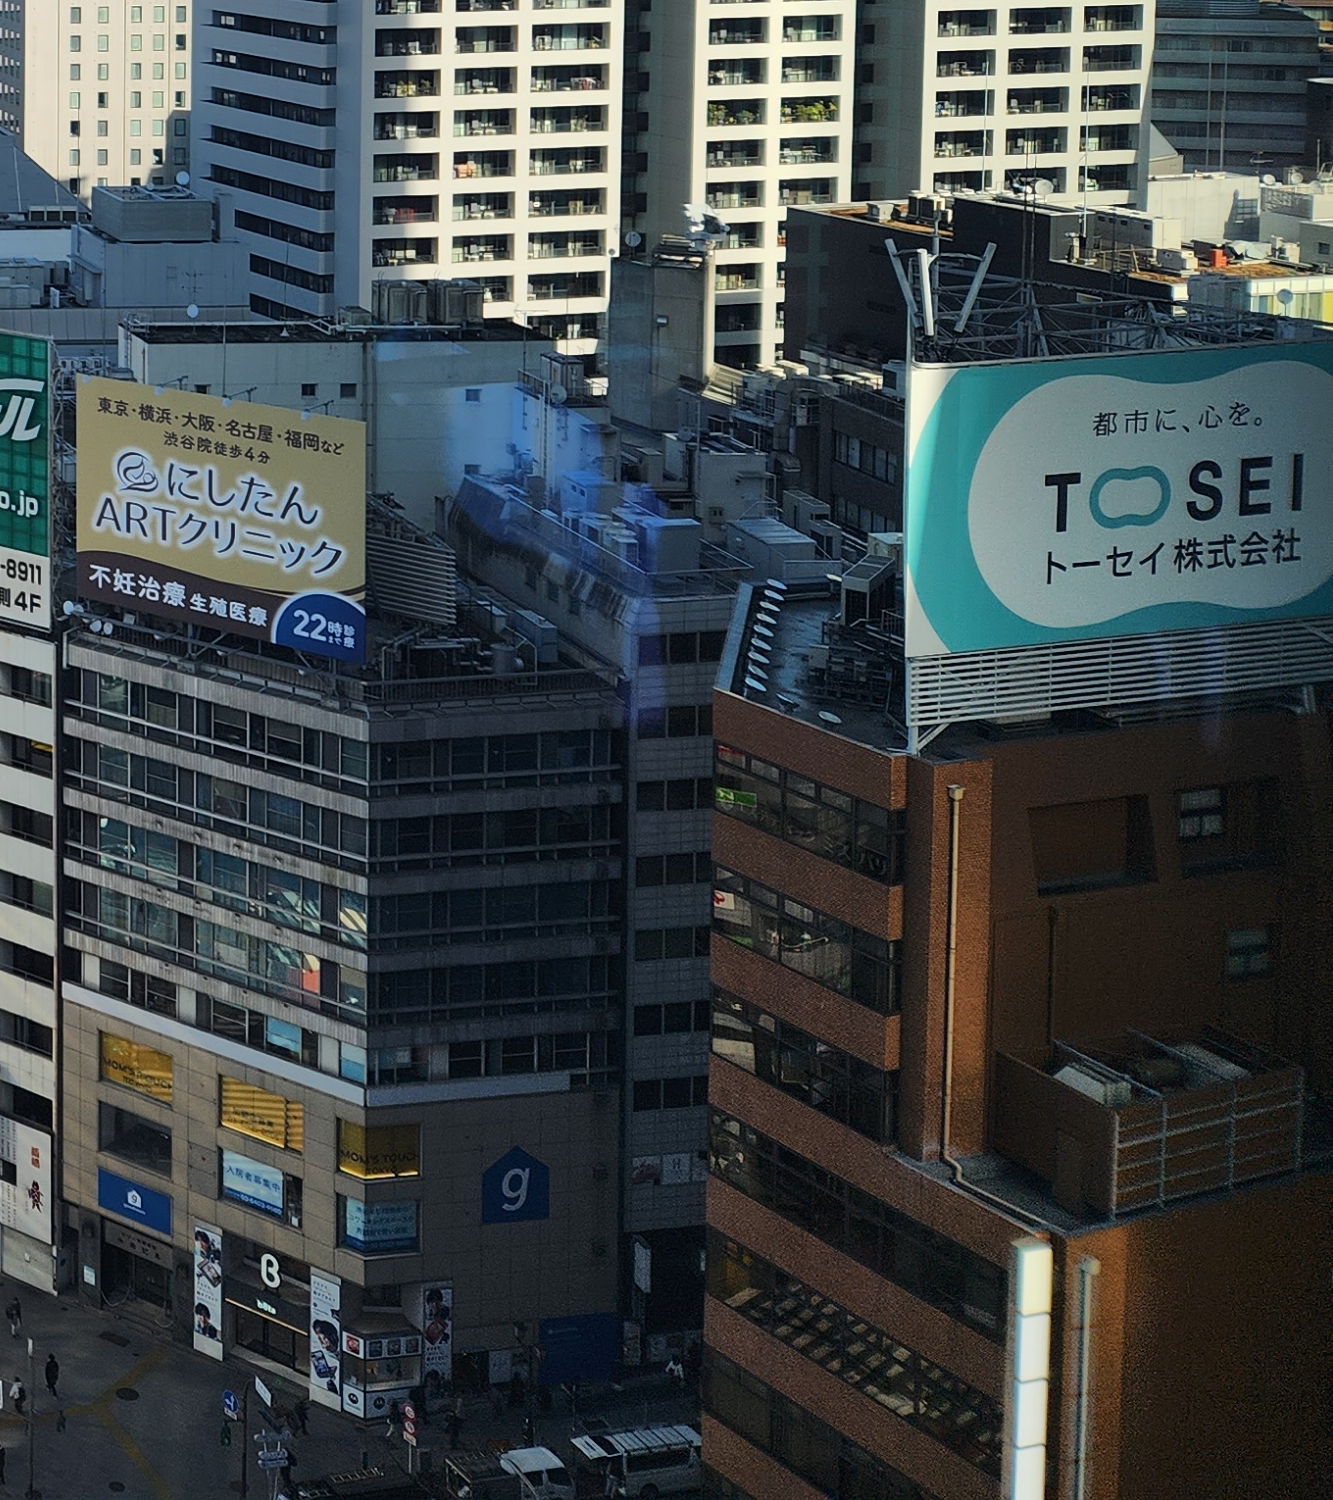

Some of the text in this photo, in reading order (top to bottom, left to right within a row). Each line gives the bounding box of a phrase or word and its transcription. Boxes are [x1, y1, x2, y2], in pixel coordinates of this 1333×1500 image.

[97, 397, 344, 456] 東京・横浜・大阪・名古屋・福岡など
[164, 431, 270, 464] 渋谷院徒歩4分
[1093, 402, 1263, 437] 都市に、心を。
[168, 462, 318, 525] にしたん
[1045, 453, 1304, 533] TOSEI
[96, 497, 343, 574] ARTクリニック
[1047, 528, 1301, 584] トーセイ株式会社
[89, 564, 268, 627] 不妊治療 生殖医療
[226, 1162, 281, 1193] 入居者募集中
[501, 1167, 530, 1211] g
